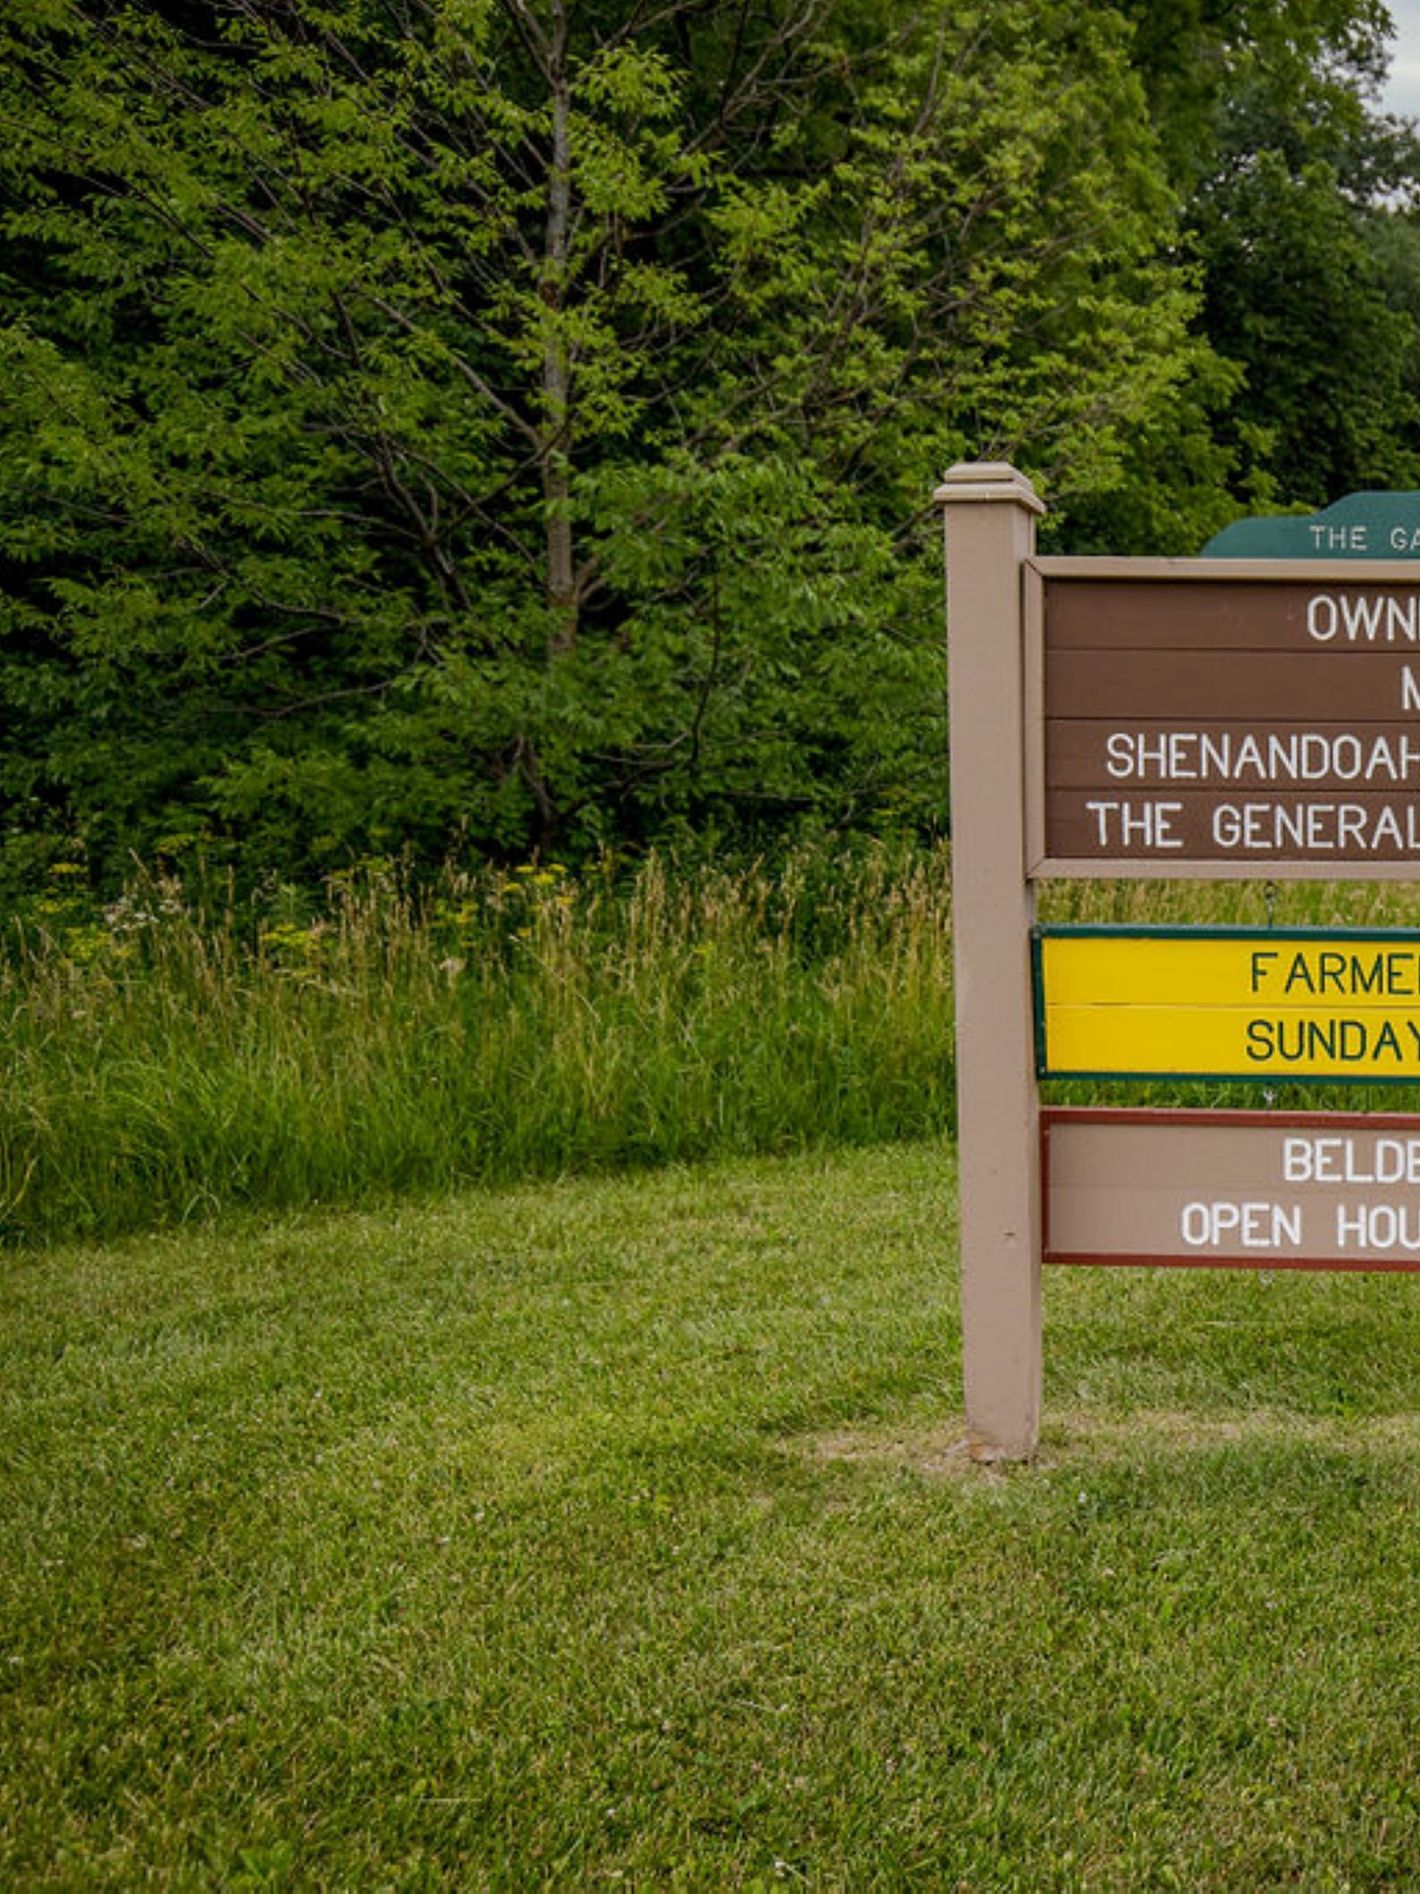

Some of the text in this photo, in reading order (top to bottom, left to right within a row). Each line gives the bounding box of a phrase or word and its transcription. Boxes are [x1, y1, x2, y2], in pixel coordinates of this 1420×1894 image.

[1311, 526, 1366, 549] THE
[1087, 803, 1182, 847] THE
[1183, 1203, 1300, 1246] OPEN
